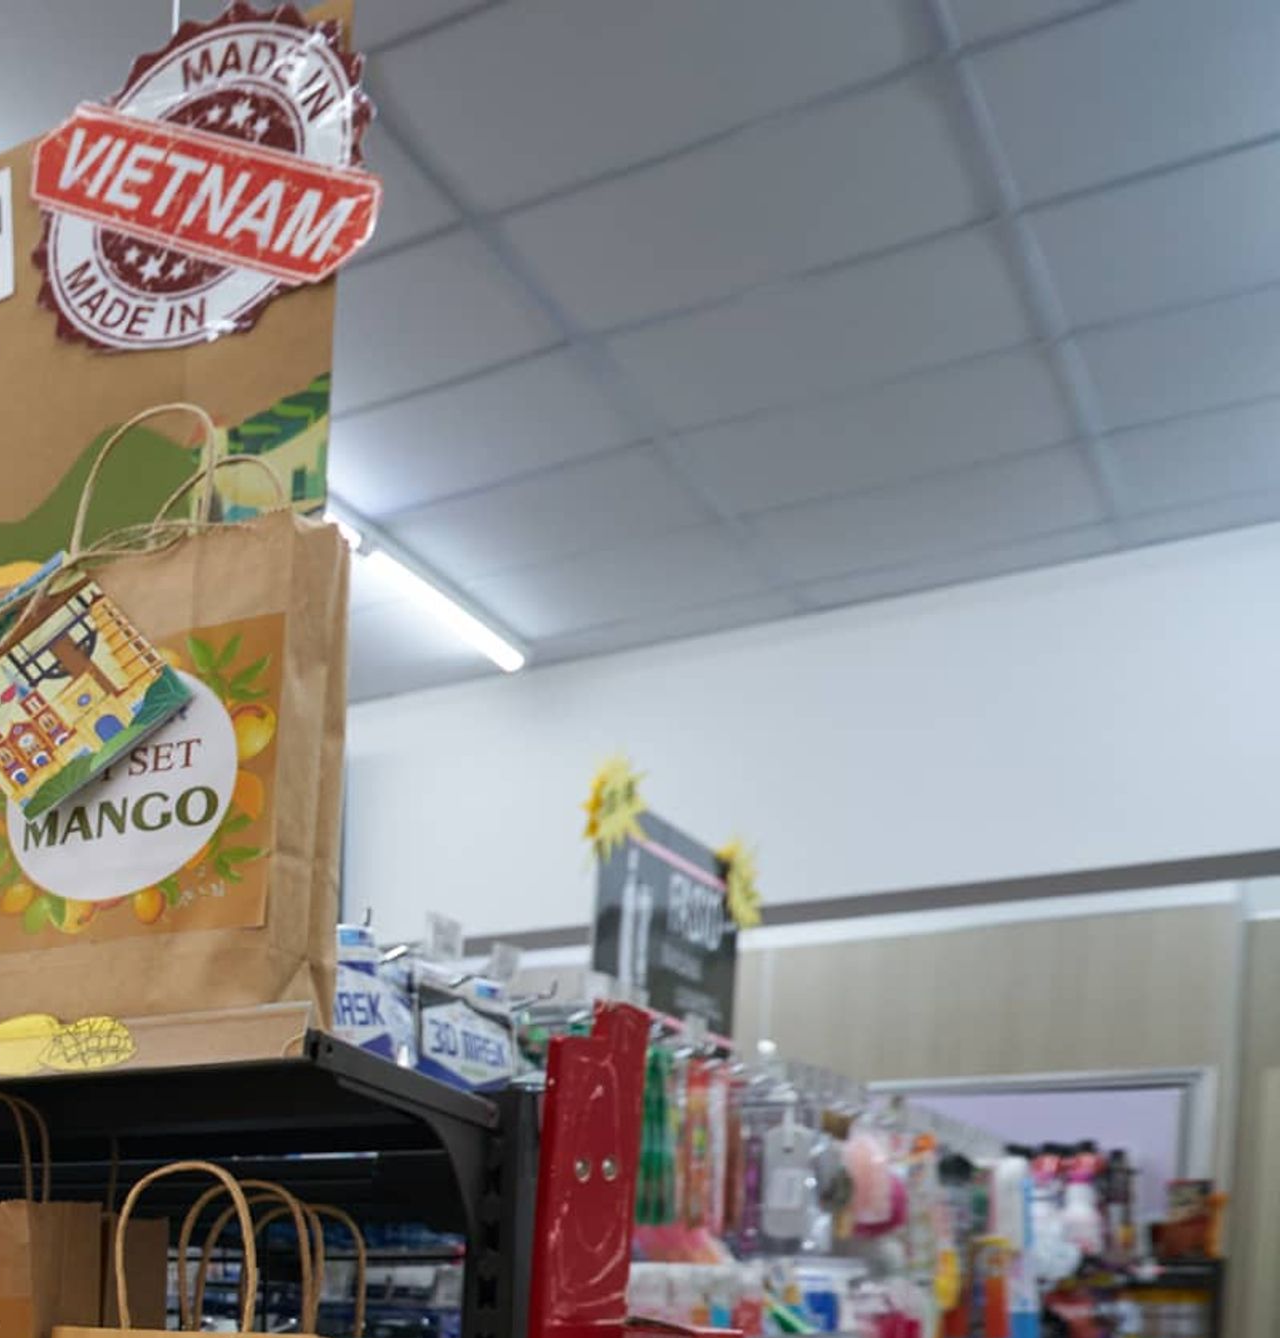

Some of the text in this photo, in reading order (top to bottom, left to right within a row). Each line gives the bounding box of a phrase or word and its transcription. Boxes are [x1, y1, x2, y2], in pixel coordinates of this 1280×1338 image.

[181, 40, 337, 124] MADE IN
[56, 127, 359, 264] VIETNAM
[64, 260, 207, 338] MADE IN
[127, 737, 201, 777] SET
[22, 786, 220, 853] MANGO
